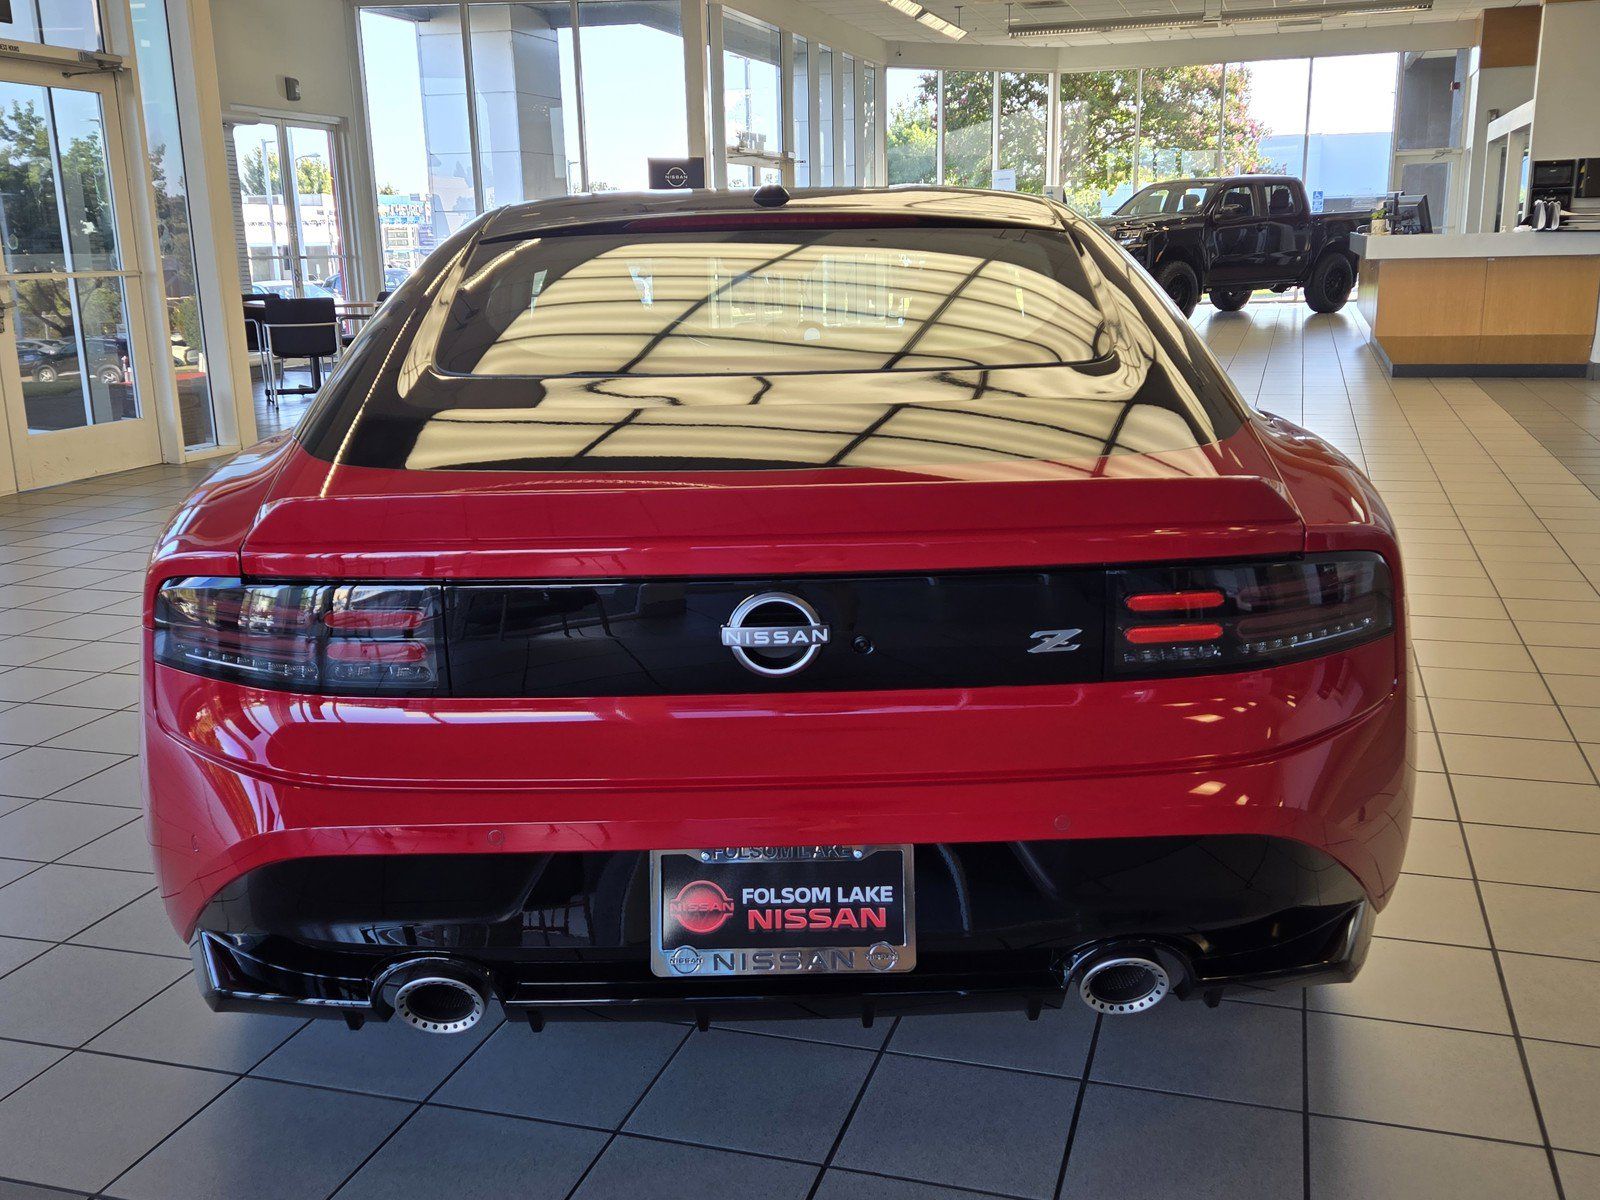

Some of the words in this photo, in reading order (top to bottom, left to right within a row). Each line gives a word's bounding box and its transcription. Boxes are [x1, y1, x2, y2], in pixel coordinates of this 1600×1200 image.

[724, 627, 829, 646] NISSAN
[1027, 628, 1083, 653] Z
[742, 886, 831, 904] FOLSOM
[837, 885, 894, 903] LAKE
[669, 902, 735, 912] NISSAN
[748, 907, 887, 930] NISSAN
[713, 951, 855, 971] NISSAN
